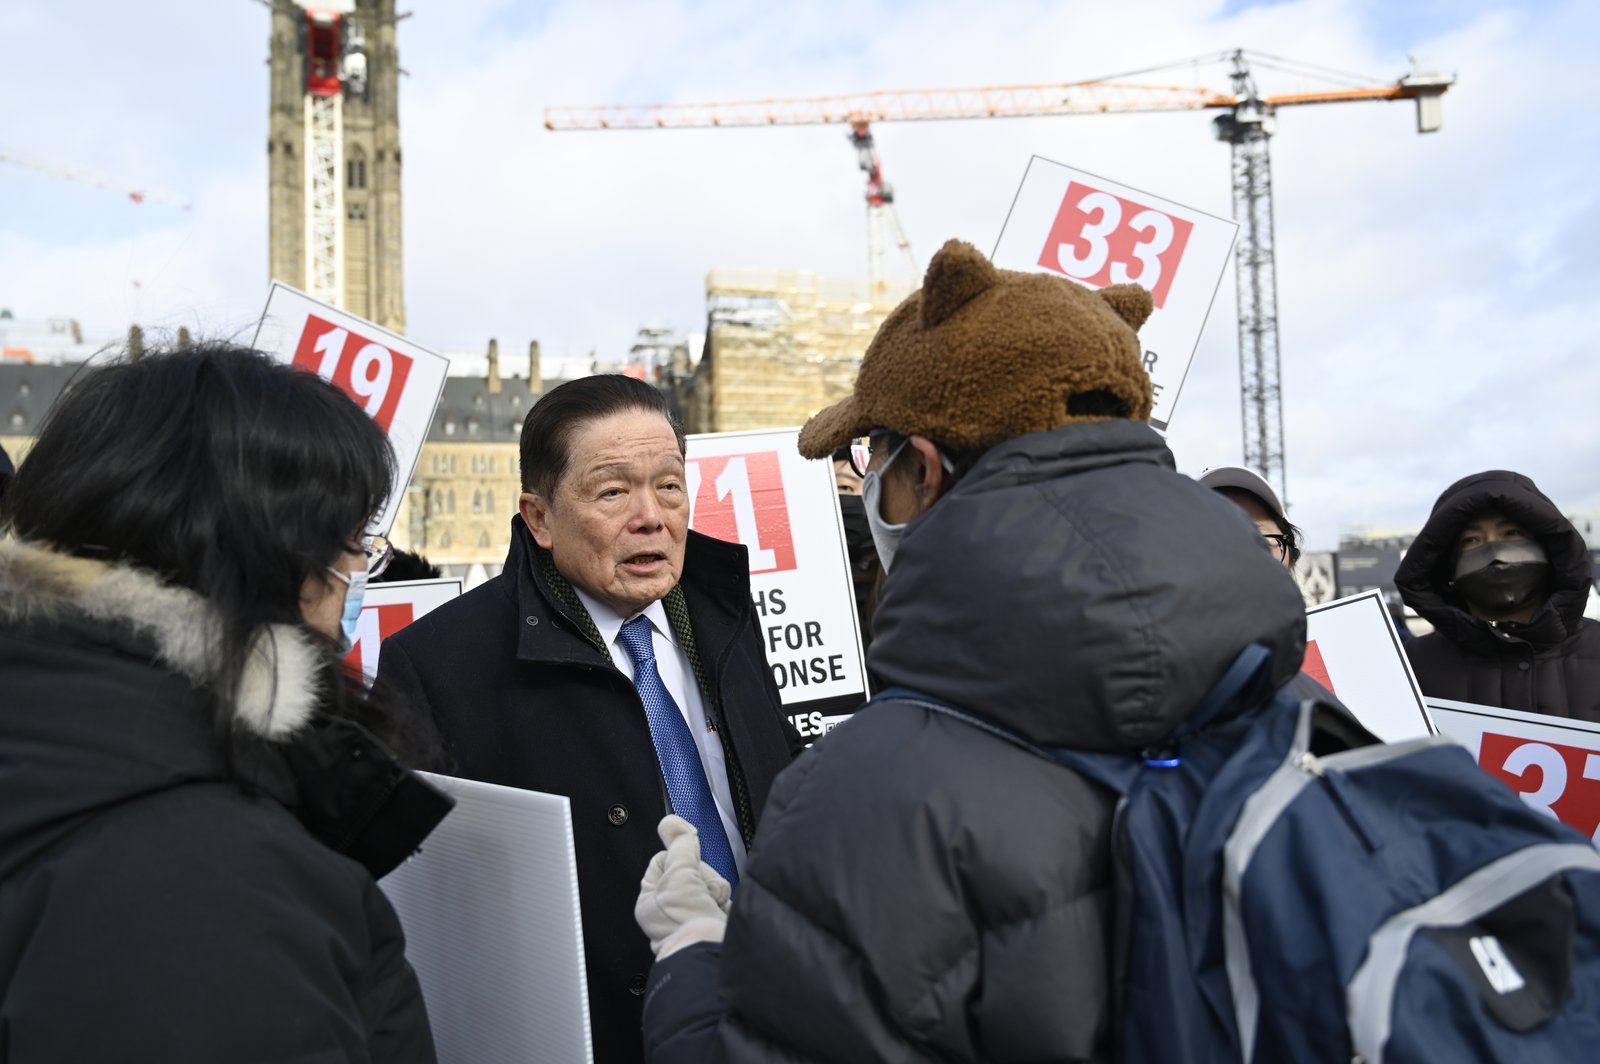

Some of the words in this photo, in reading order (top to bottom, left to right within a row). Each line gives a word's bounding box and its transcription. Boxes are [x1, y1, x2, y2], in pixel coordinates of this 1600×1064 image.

[1058, 192, 1175, 293] 33
[313, 327, 393, 419] 19
[768, 621, 824, 653] FOR
